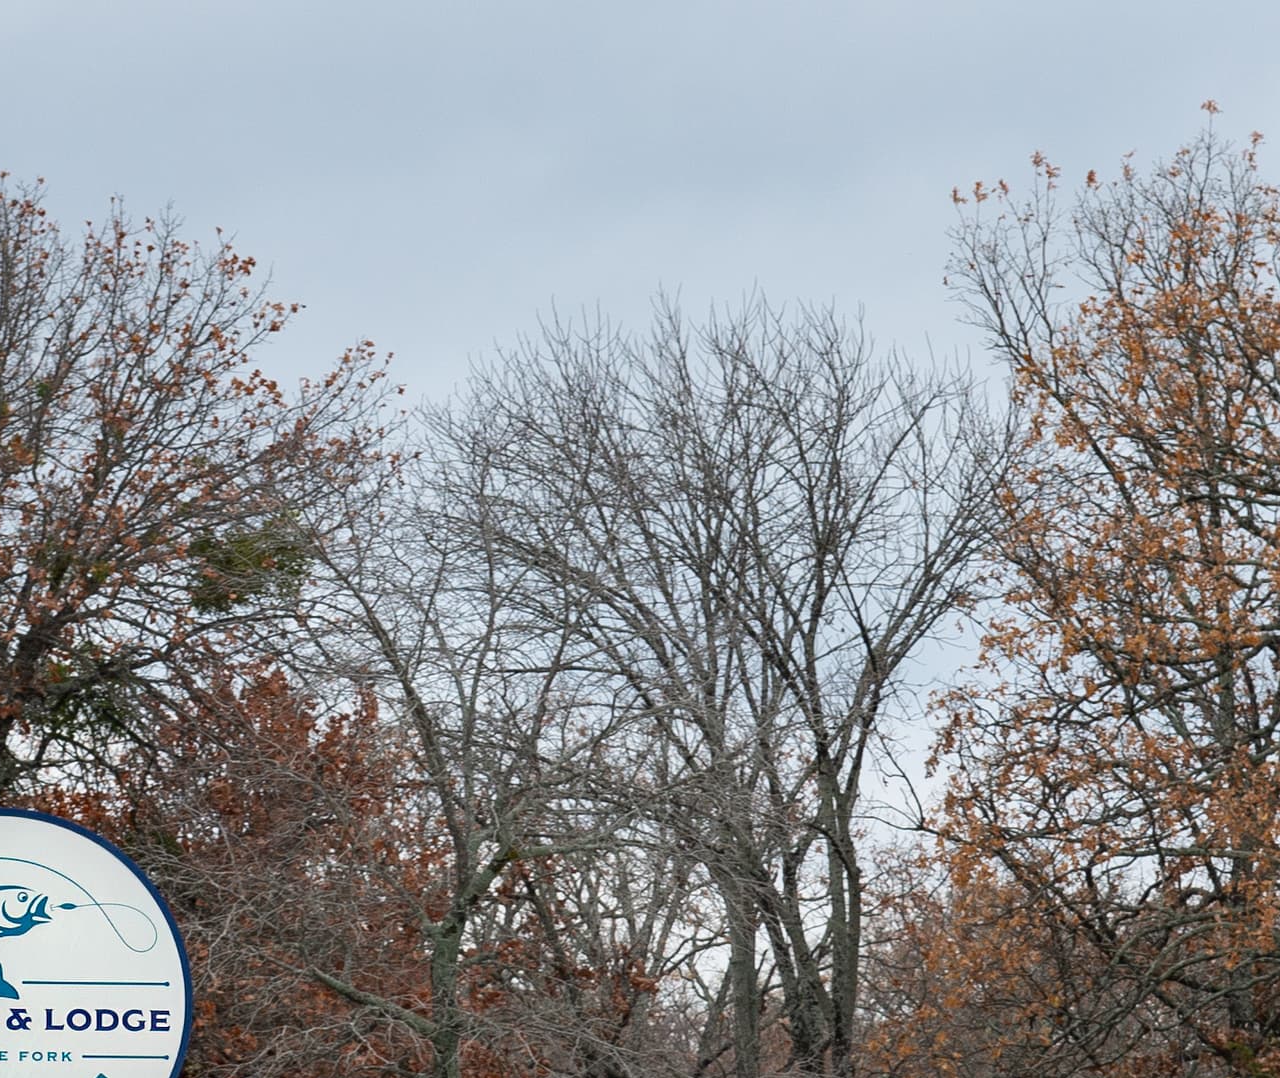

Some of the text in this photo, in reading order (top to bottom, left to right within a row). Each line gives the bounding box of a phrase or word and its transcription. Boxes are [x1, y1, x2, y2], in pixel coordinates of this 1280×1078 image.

[6, 1008, 32, 1031] &
[45, 1008, 171, 1032] LODGE
[19, 1051, 73, 1062] FORK
